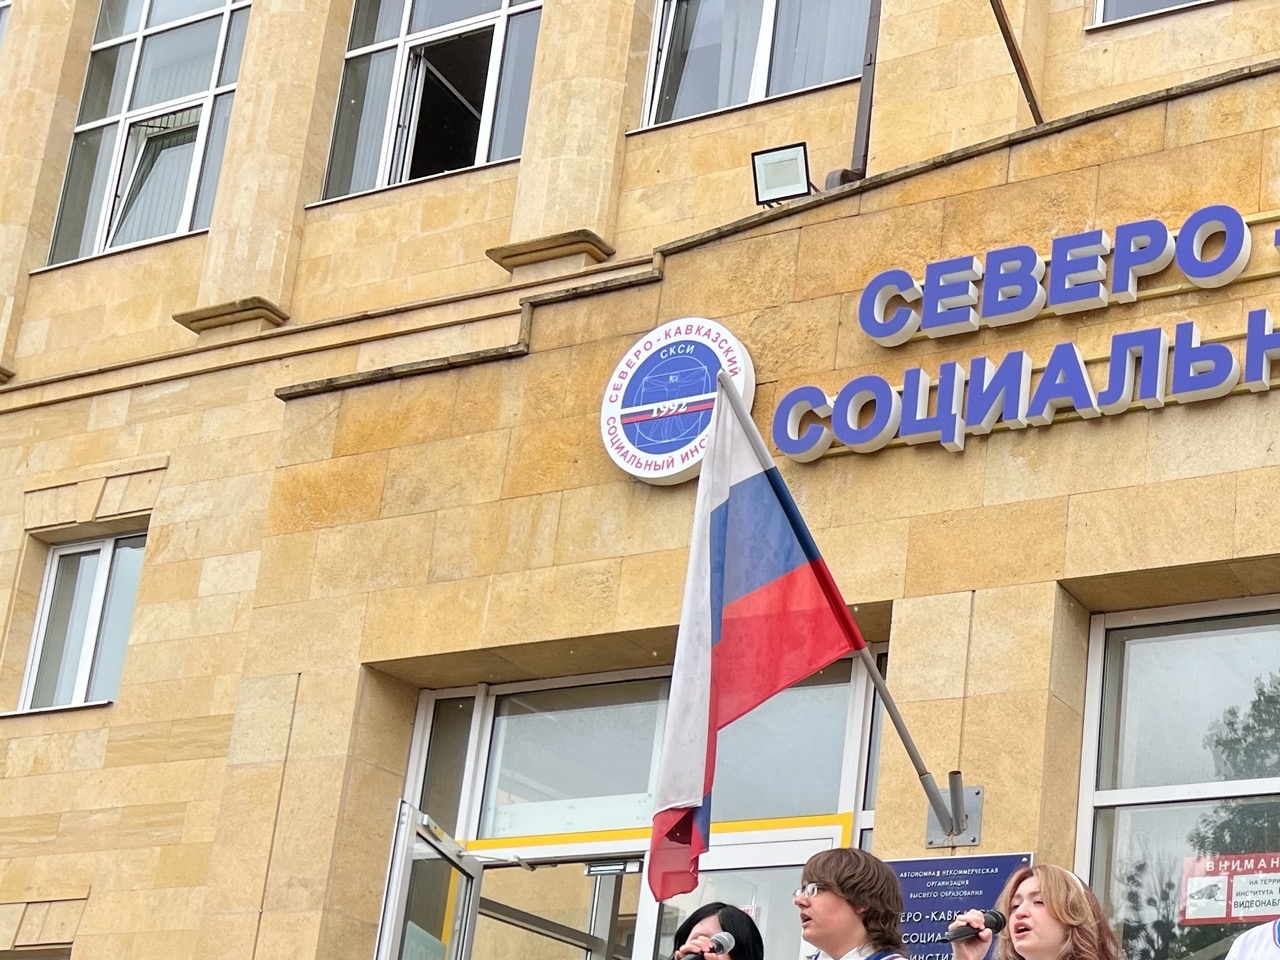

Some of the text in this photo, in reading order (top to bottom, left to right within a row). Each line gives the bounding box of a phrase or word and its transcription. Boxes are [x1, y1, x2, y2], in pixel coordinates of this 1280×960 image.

[858, 205, 1247, 339] СЕВЕРО
[660, 344, 695, 359] СКСИ
[651, 401, 688, 418] 1992
[606, 416, 675, 471] СОЦИАЛЬНЫЙ
[900, 867, 999, 878] АВТОНОМНАЯ НЕКОММЕРЧЕСКАЯ
[926, 880, 969, 888] ОРГАНИЗАЦИЯ
[940, 890, 983, 898] ОБРАЗОВАНИЯ
[1235, 889, 1274, 897] ИНСТИТУТА
[900, 912, 922, 923] ЕРО
[901, 932, 948, 944] СОЦИА
